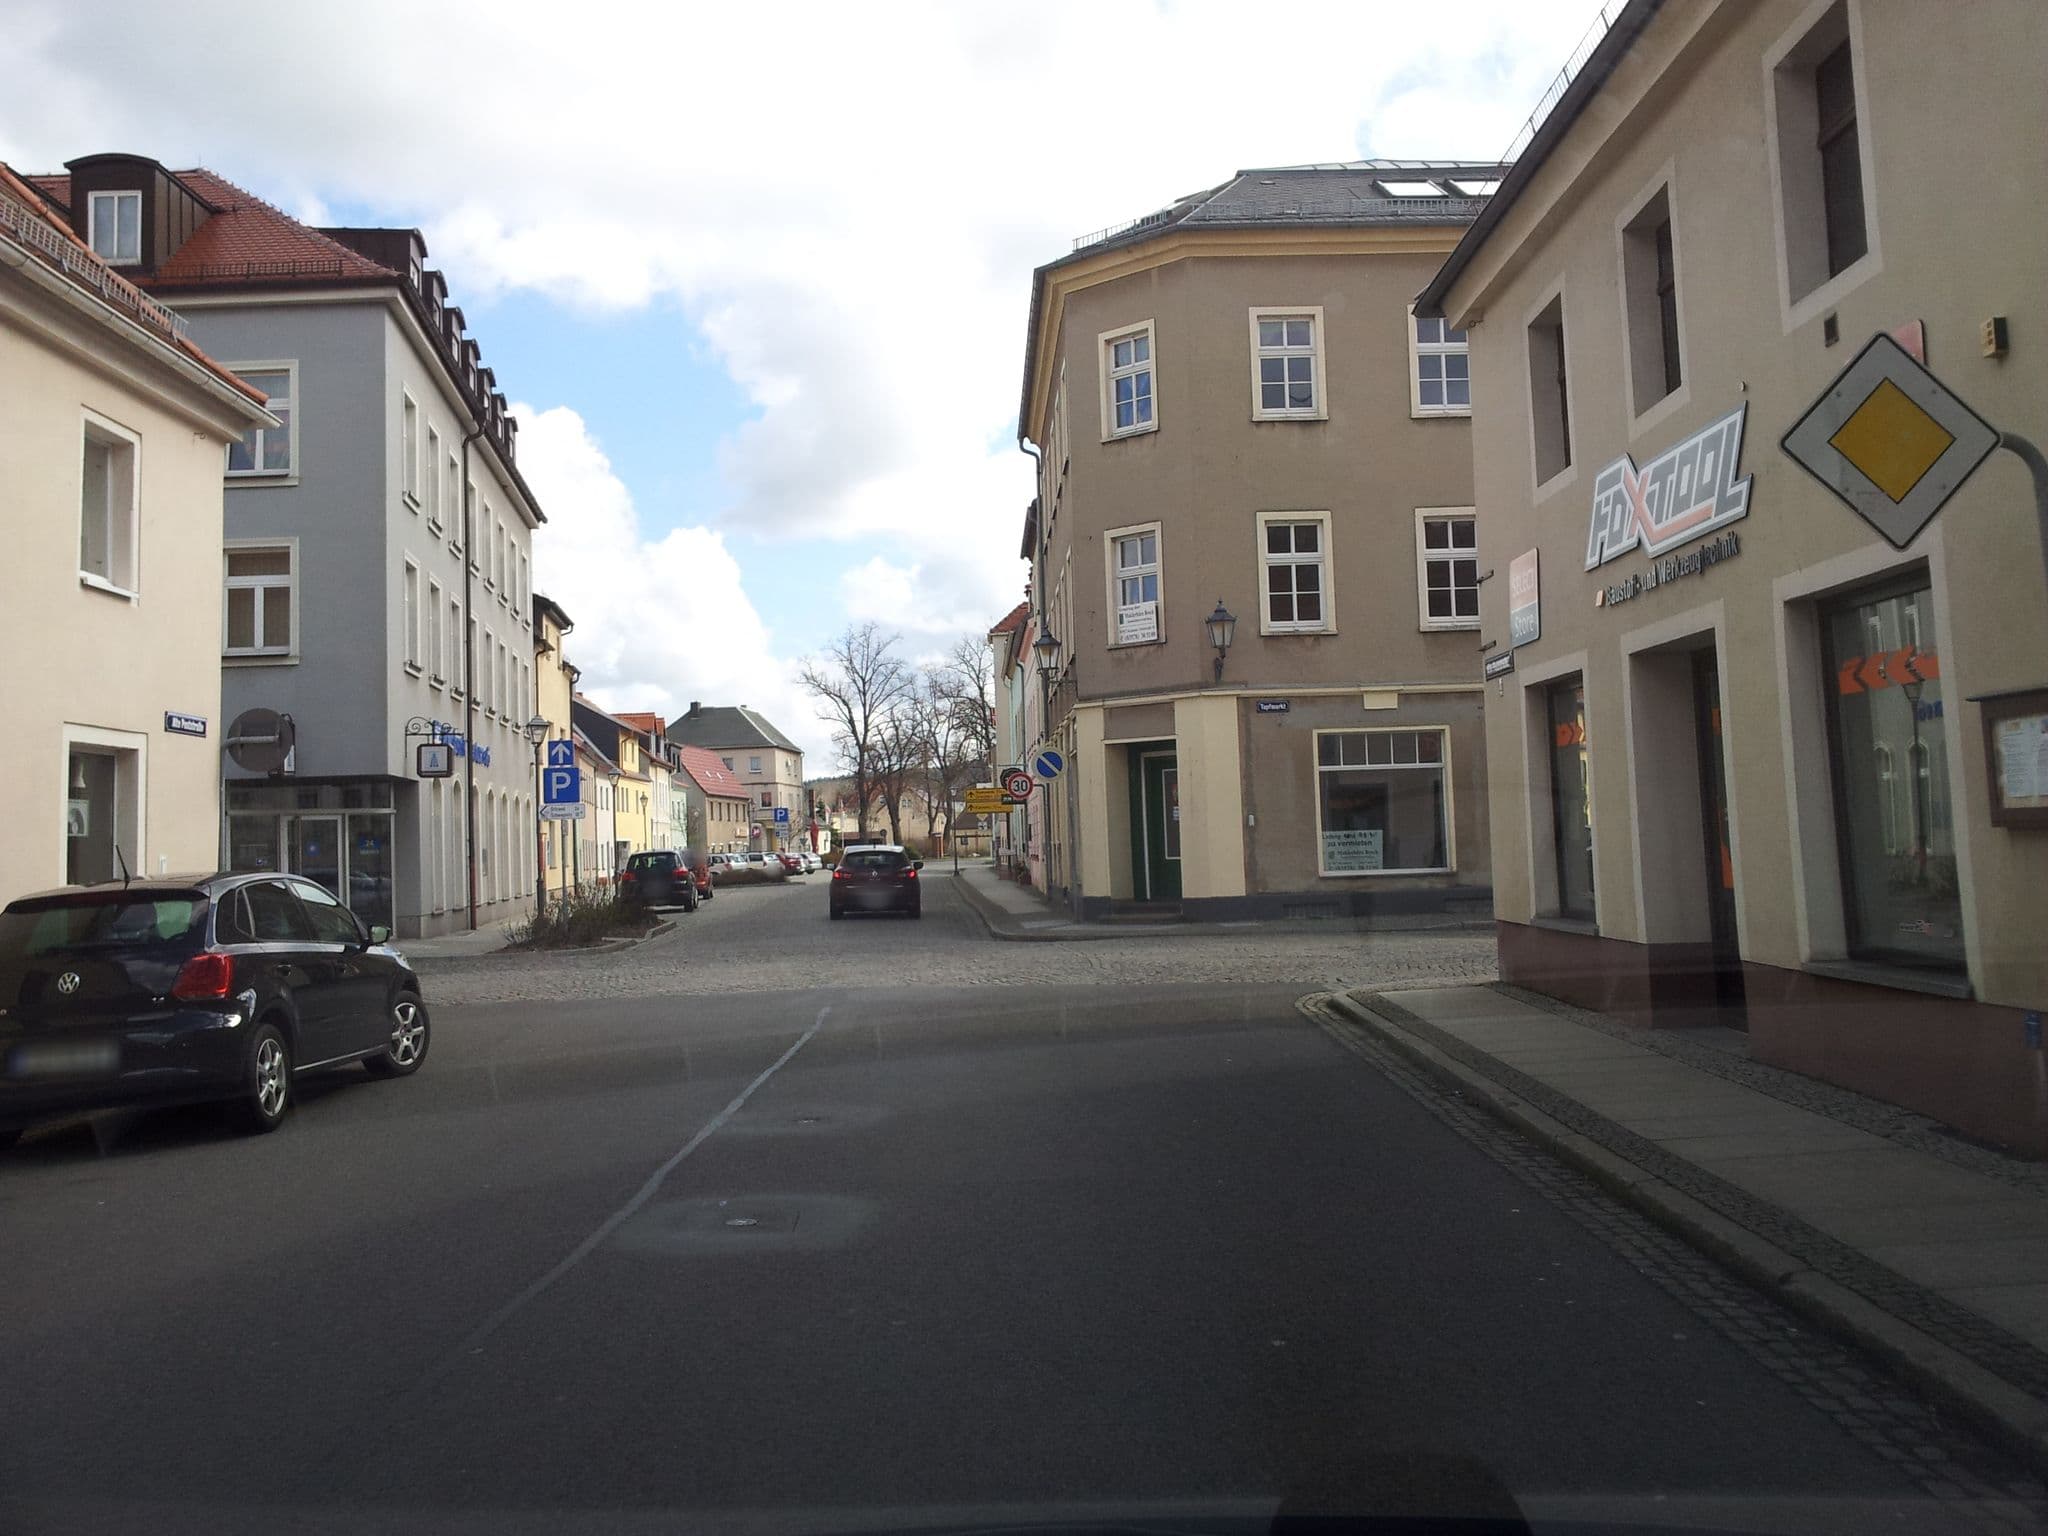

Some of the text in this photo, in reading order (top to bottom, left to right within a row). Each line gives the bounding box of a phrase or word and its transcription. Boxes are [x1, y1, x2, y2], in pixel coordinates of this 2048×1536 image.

[1641, 564, 1658, 592] und
[1514, 612, 1535, 639] Store
[551, 771, 571, 800] P
[1012, 779, 1029, 793] 30
[776, 809, 785, 821] P
